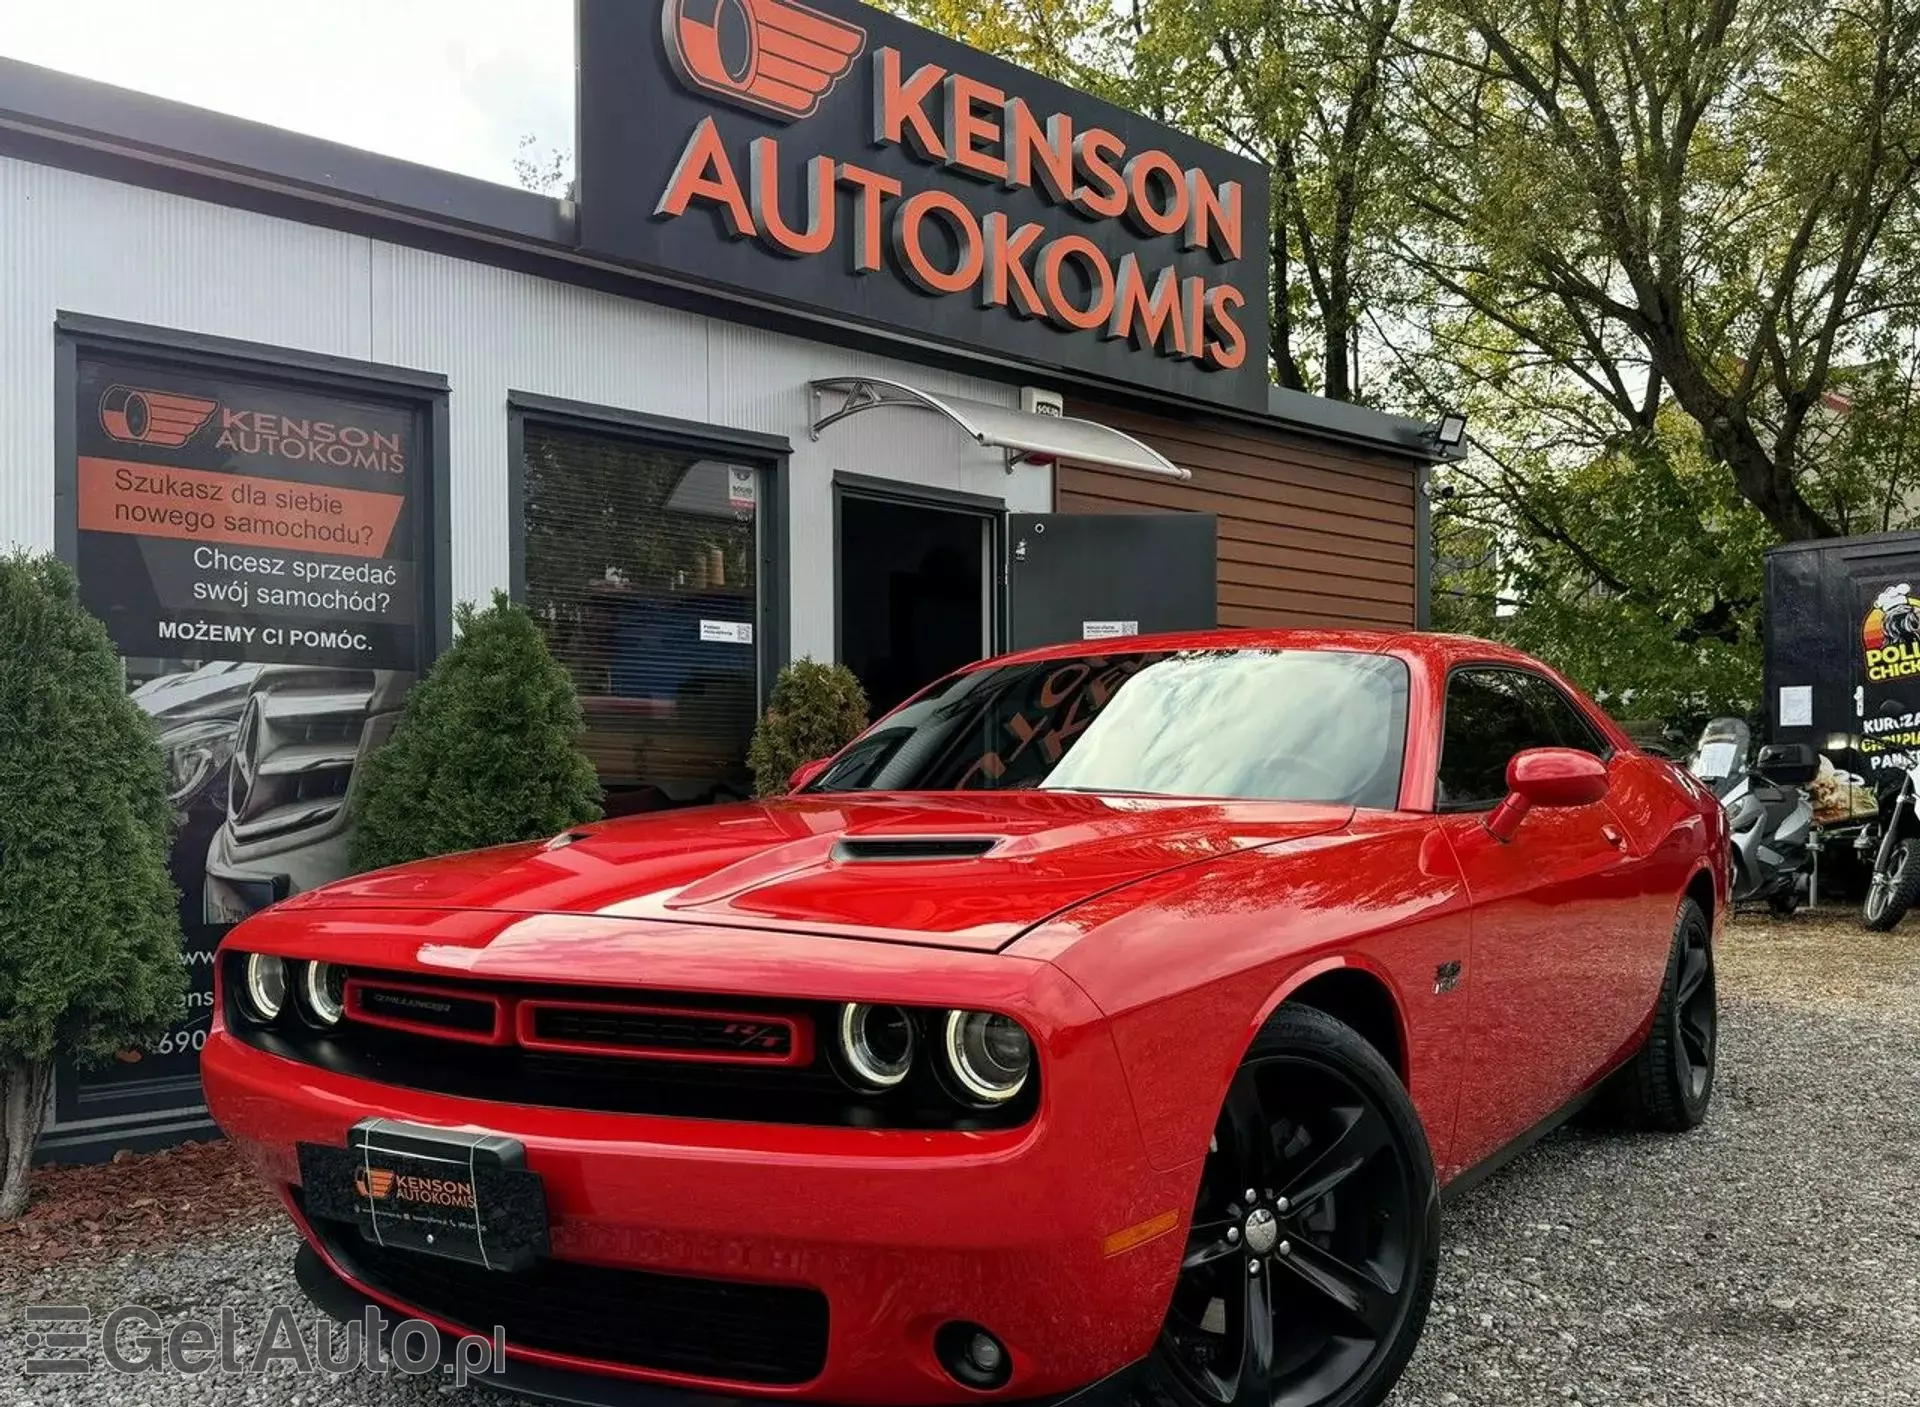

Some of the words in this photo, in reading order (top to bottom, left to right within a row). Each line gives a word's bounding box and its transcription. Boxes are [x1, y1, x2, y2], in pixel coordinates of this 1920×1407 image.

[873, 46, 1242, 262] KENSON
[653, 115, 1247, 370] AUTOKOMIS
[214, 427, 406, 474] AUTOKOMIS
[222, 407, 401, 452] KENSON
[115, 468, 224, 502] Szukasz
[231, 484, 267, 507] dla
[275, 491, 343, 516] siebie
[115, 503, 215, 531] nowego
[224, 515, 374, 547] samochodu?
[193, 546, 285, 576] Chcesz
[293, 556, 397, 586] sprzedać
[193, 577, 249, 608] swój
[257, 585, 391, 614] samochód?
[158, 619, 254, 644] MOŻEMY
[262, 629, 284, 645] CI
[289, 628, 373, 651] POMÓC.
[396, 1176, 471, 1195] KENSON
[396, 1189, 476, 1209] AUTOKOMIS
